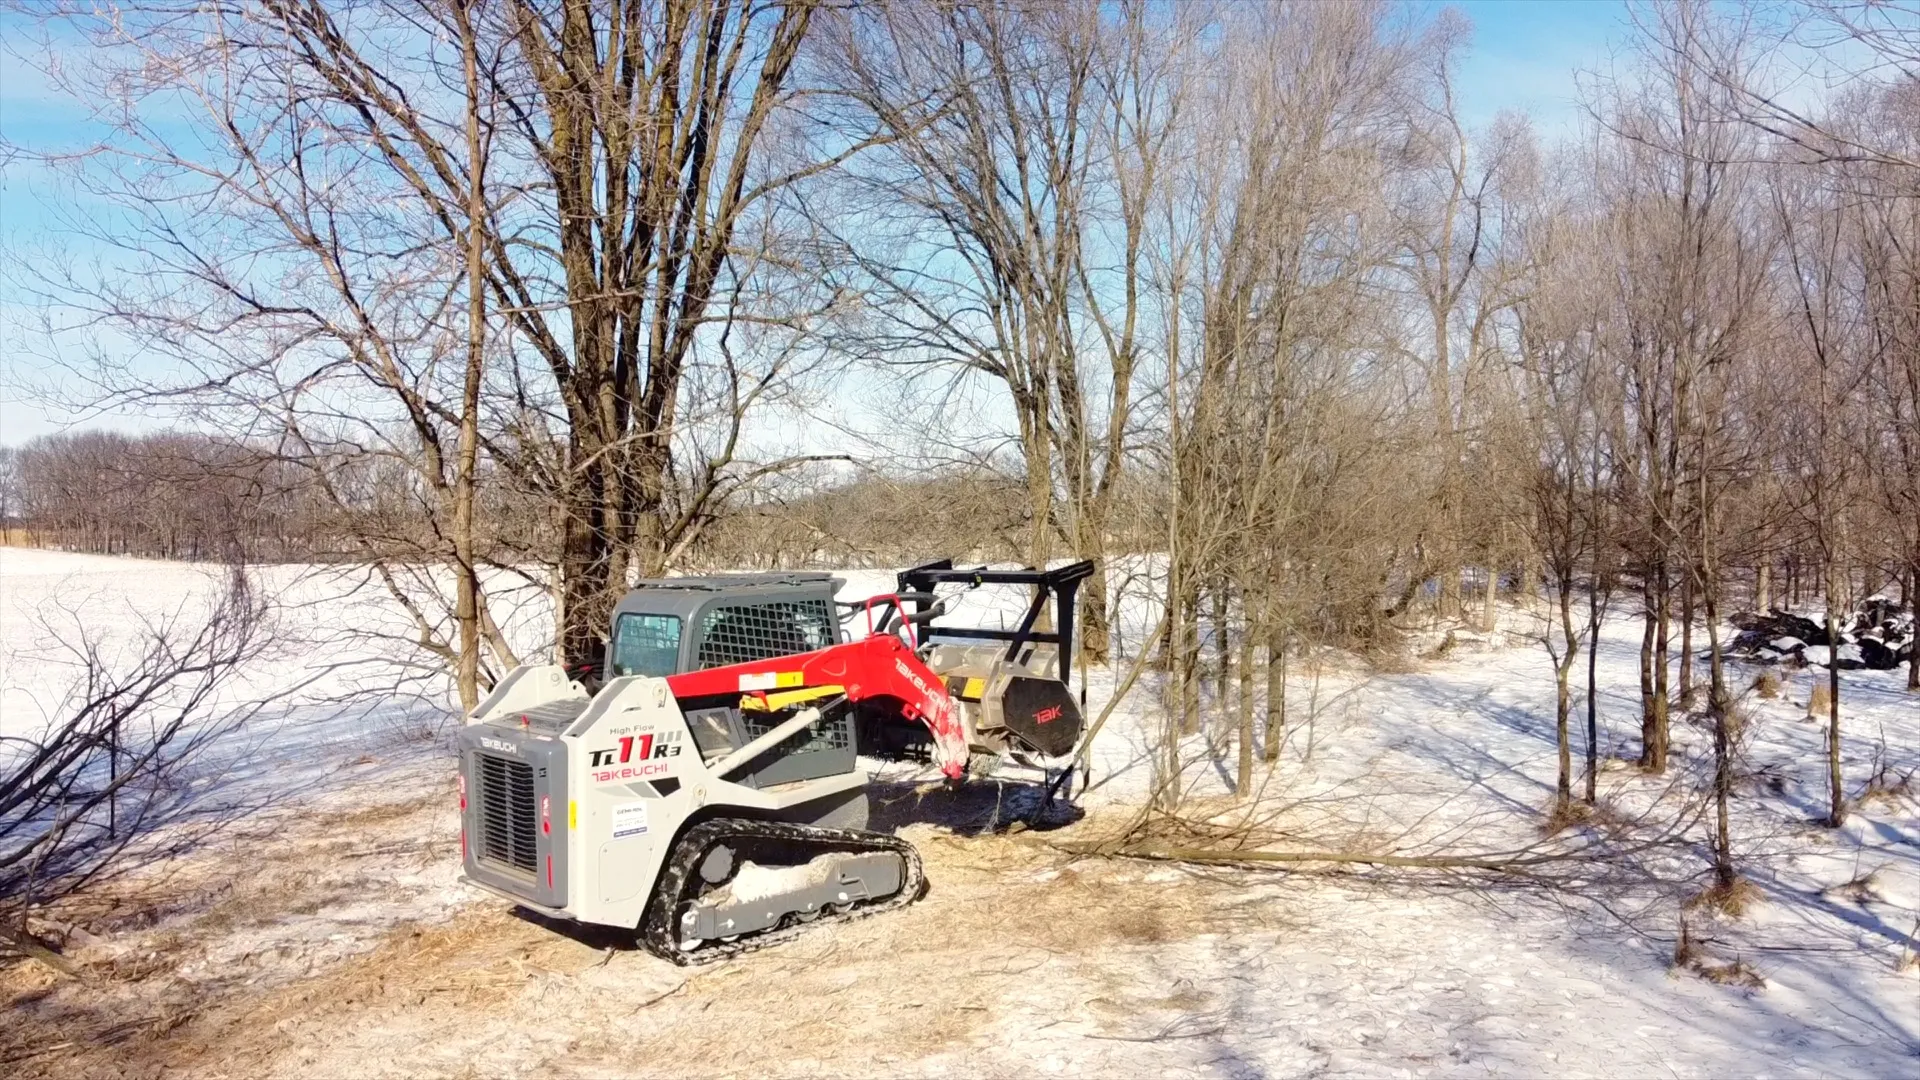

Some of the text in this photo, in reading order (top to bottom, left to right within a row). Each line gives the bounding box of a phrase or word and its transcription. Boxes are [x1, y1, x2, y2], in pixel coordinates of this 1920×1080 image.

[609, 727, 631, 735] High
[480, 736, 517, 754] TAKEUCHI
[592, 763, 668, 782] TAKEUCHI
